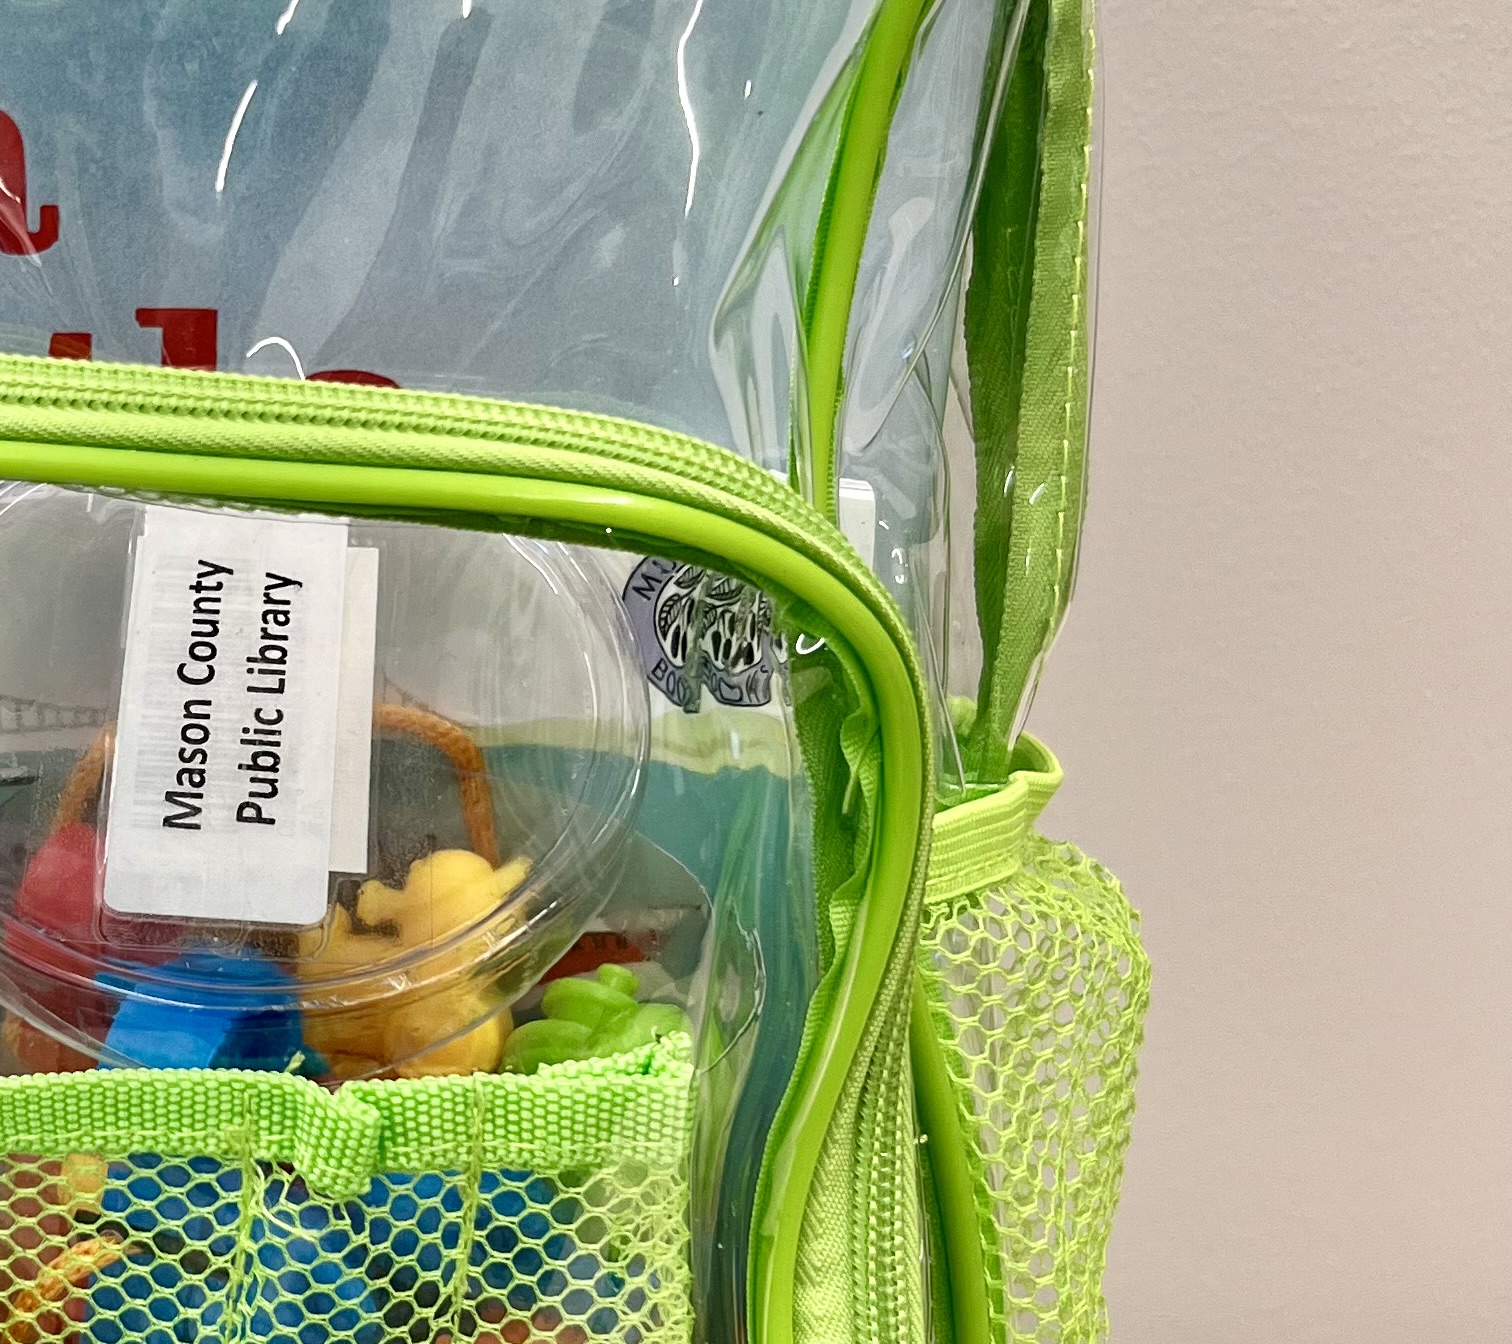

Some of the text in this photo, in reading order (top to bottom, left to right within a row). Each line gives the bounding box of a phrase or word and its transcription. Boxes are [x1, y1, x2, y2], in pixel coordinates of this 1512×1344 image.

[162, 559, 234, 831] Mason County
[235, 571, 303, 826] Public Library
